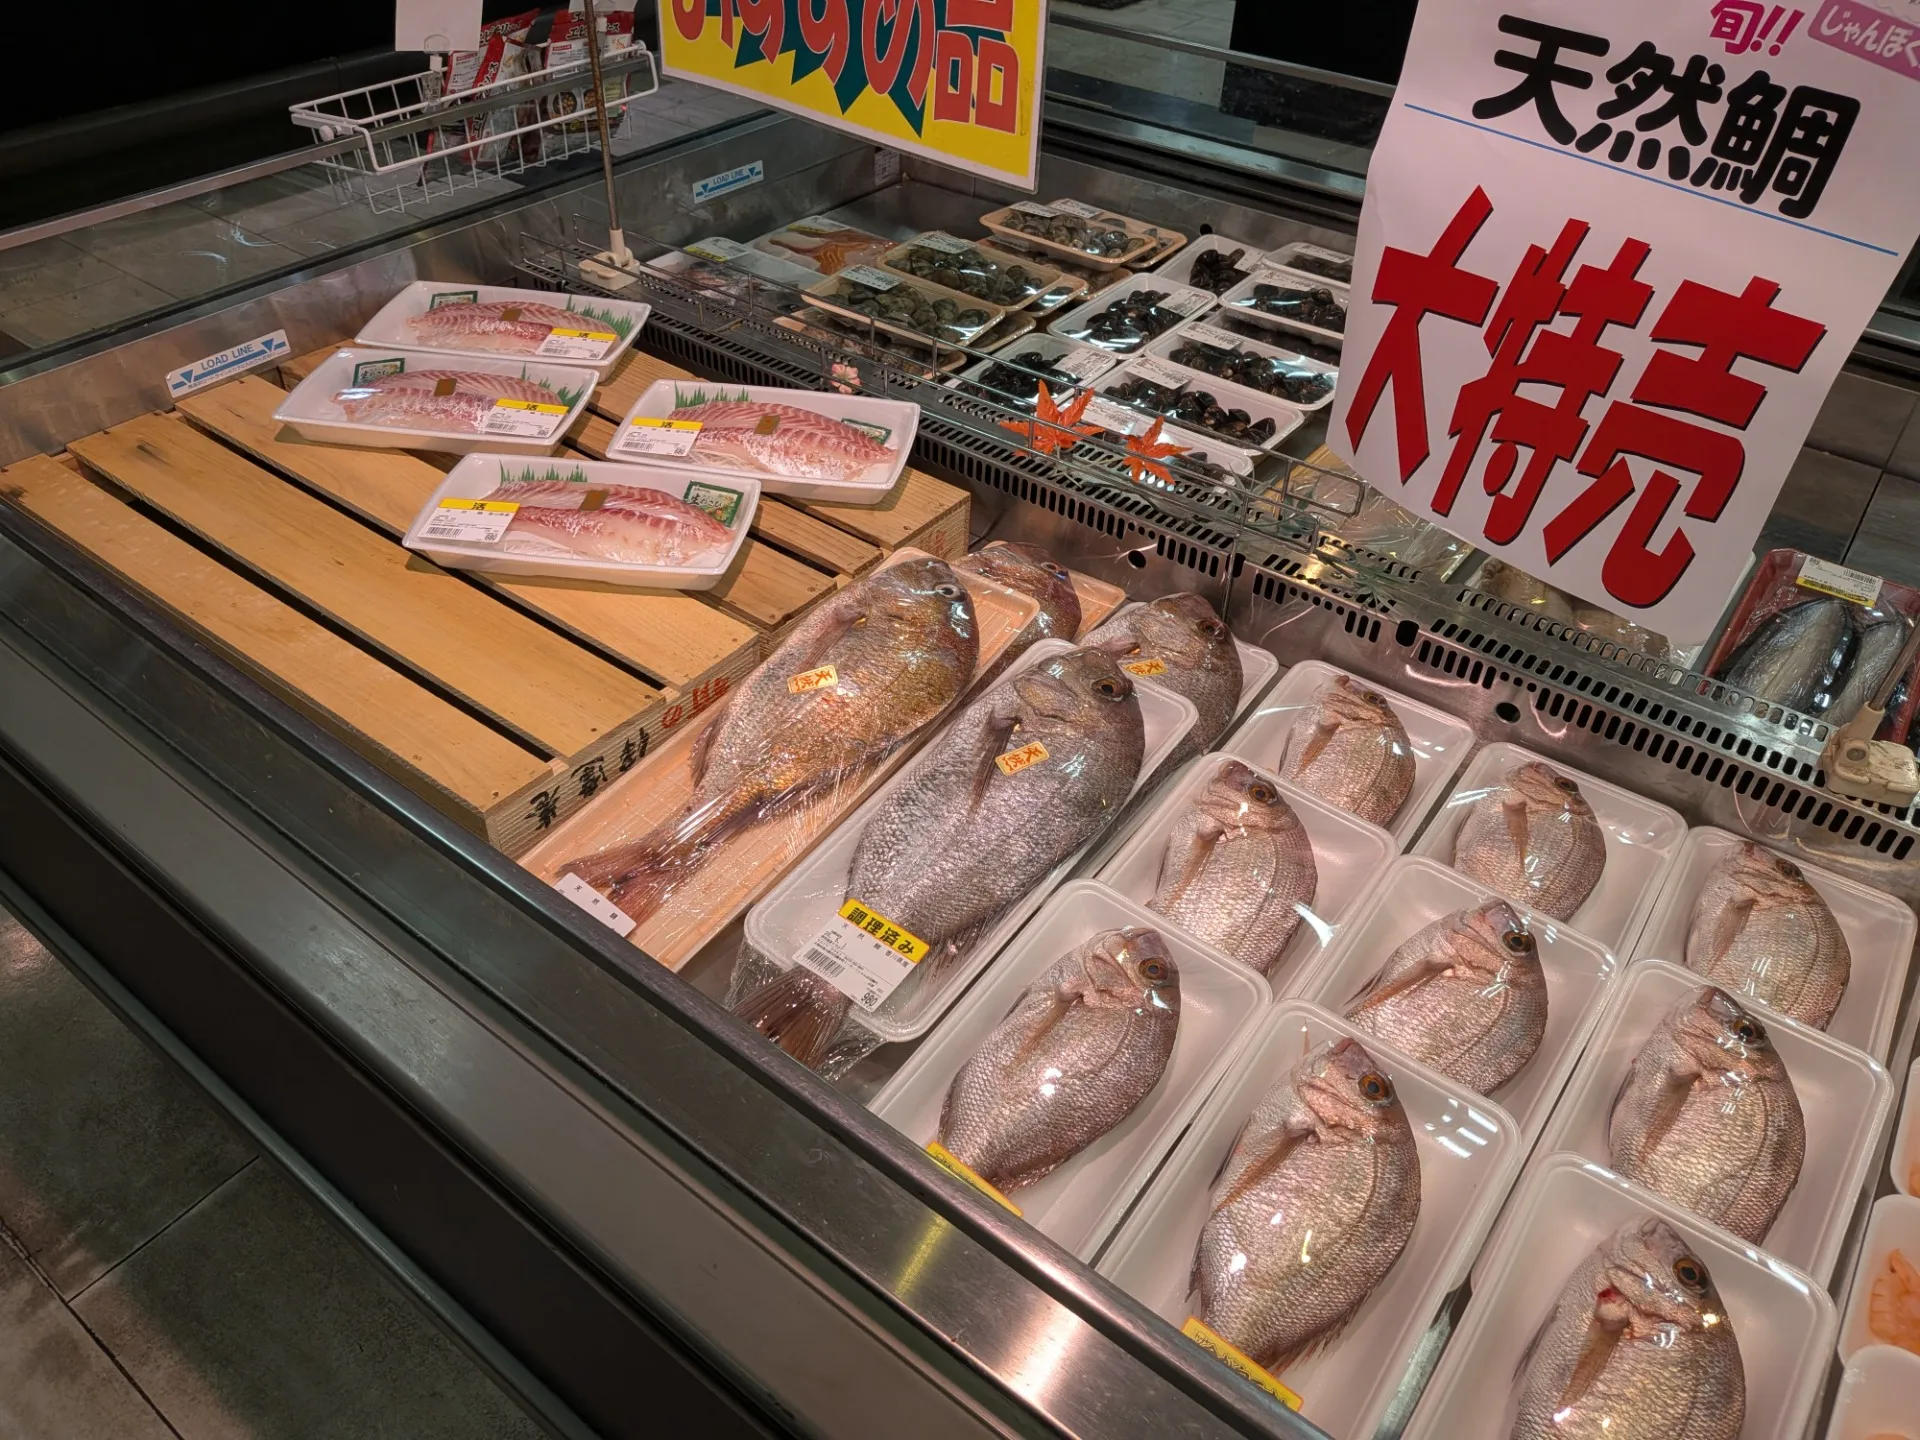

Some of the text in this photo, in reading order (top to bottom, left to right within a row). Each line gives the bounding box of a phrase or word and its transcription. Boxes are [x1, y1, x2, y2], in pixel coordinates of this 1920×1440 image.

[1472, 14, 1861, 219] 天然鯛
[200, 343, 255, 371] LOAD LINE
[1345, 184, 1827, 609] 大特売
[846, 907, 915, 954] 調理済み
